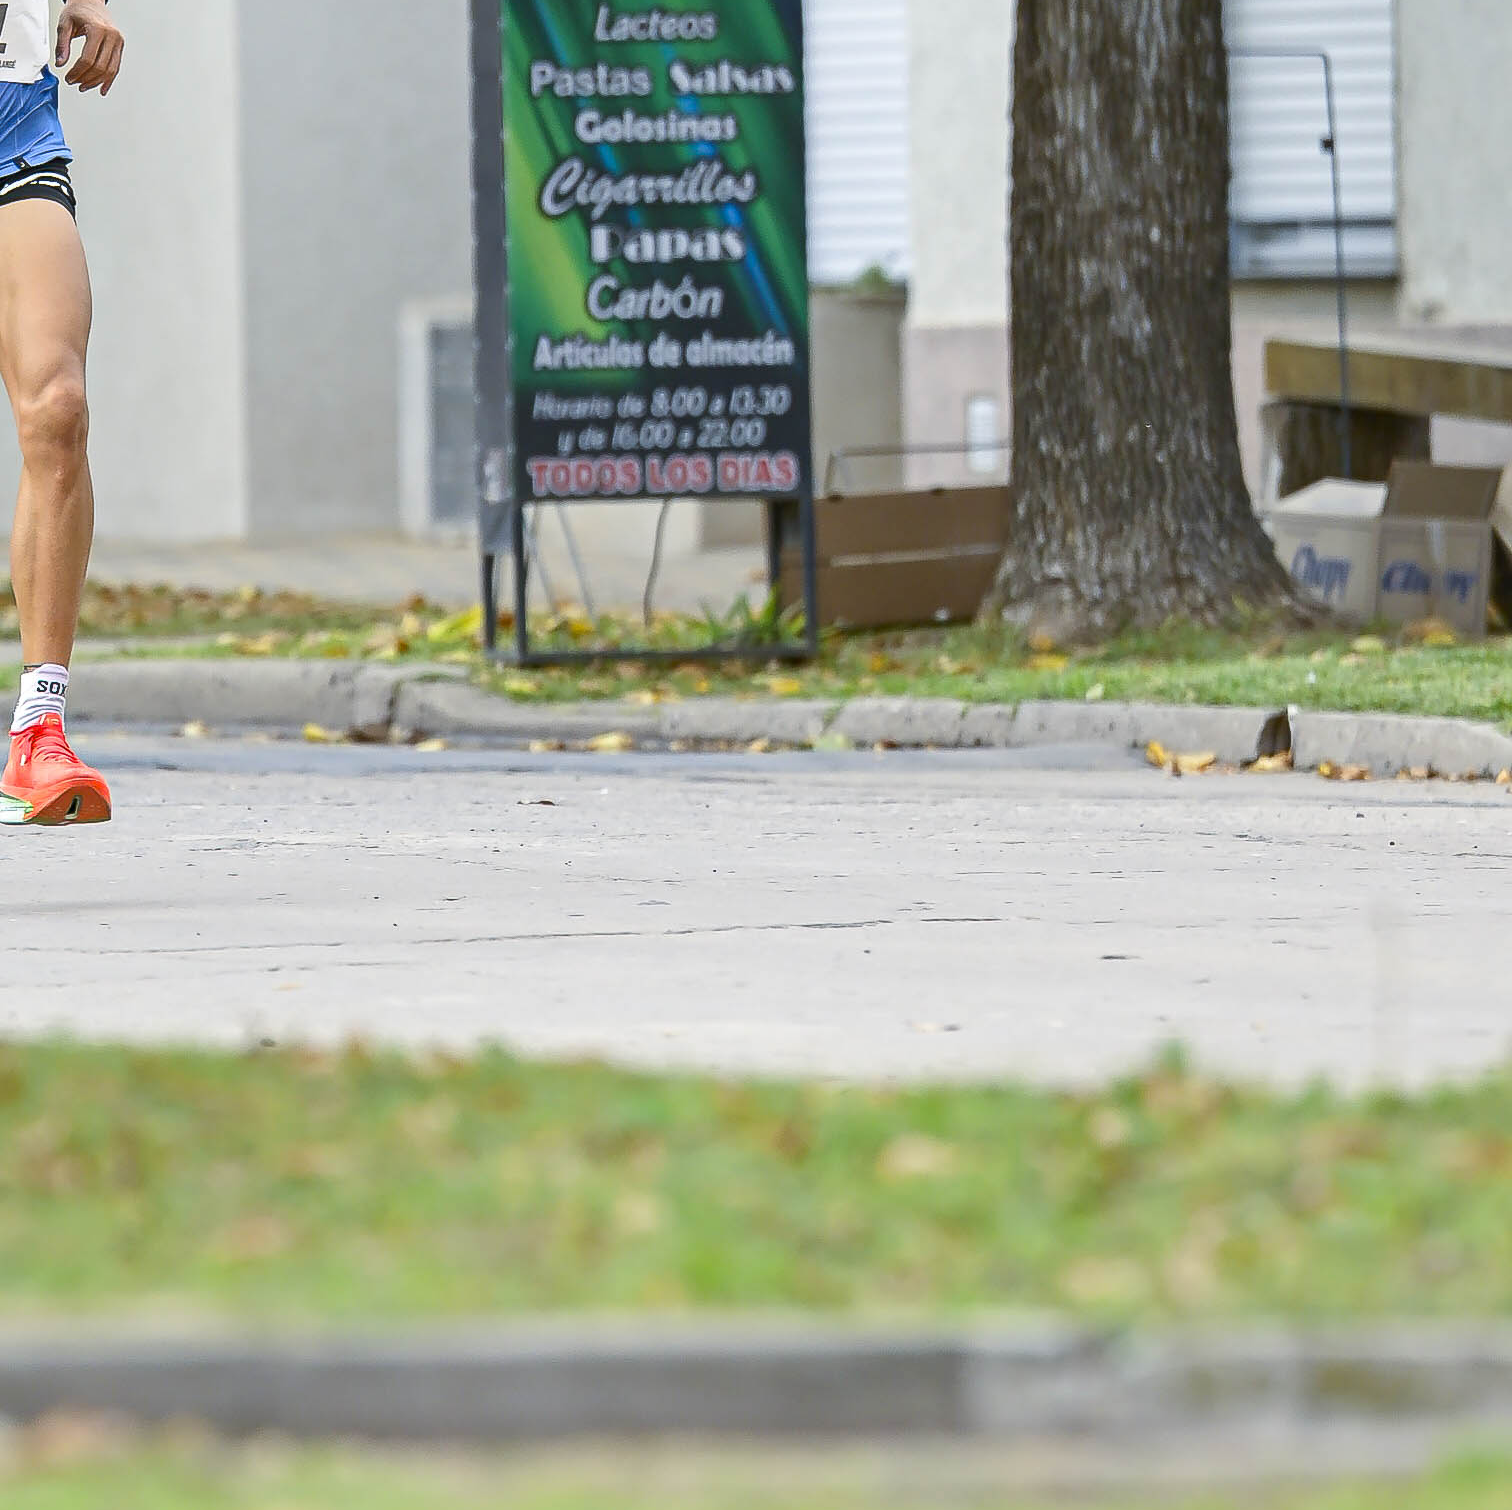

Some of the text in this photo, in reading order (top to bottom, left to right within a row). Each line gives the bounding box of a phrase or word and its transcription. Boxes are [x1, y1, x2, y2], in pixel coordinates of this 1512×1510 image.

[594, 3, 719, 41] Lacteos
[530, 61, 652, 97] Pastas
[575, 109, 738, 143] Golosinas
[541, 157, 759, 220] Cigarrillos
[590, 225, 746, 263] Papas
[589, 274, 724, 320] Carbón
[648, 331, 682, 368] de
[532, 392, 615, 419] Horario
[616, 393, 647, 418] de
[557, 430, 575, 457] y
[578, 427, 608, 451] de
[527, 455, 642, 495] TODOS
[645, 453, 714, 494] LOS
